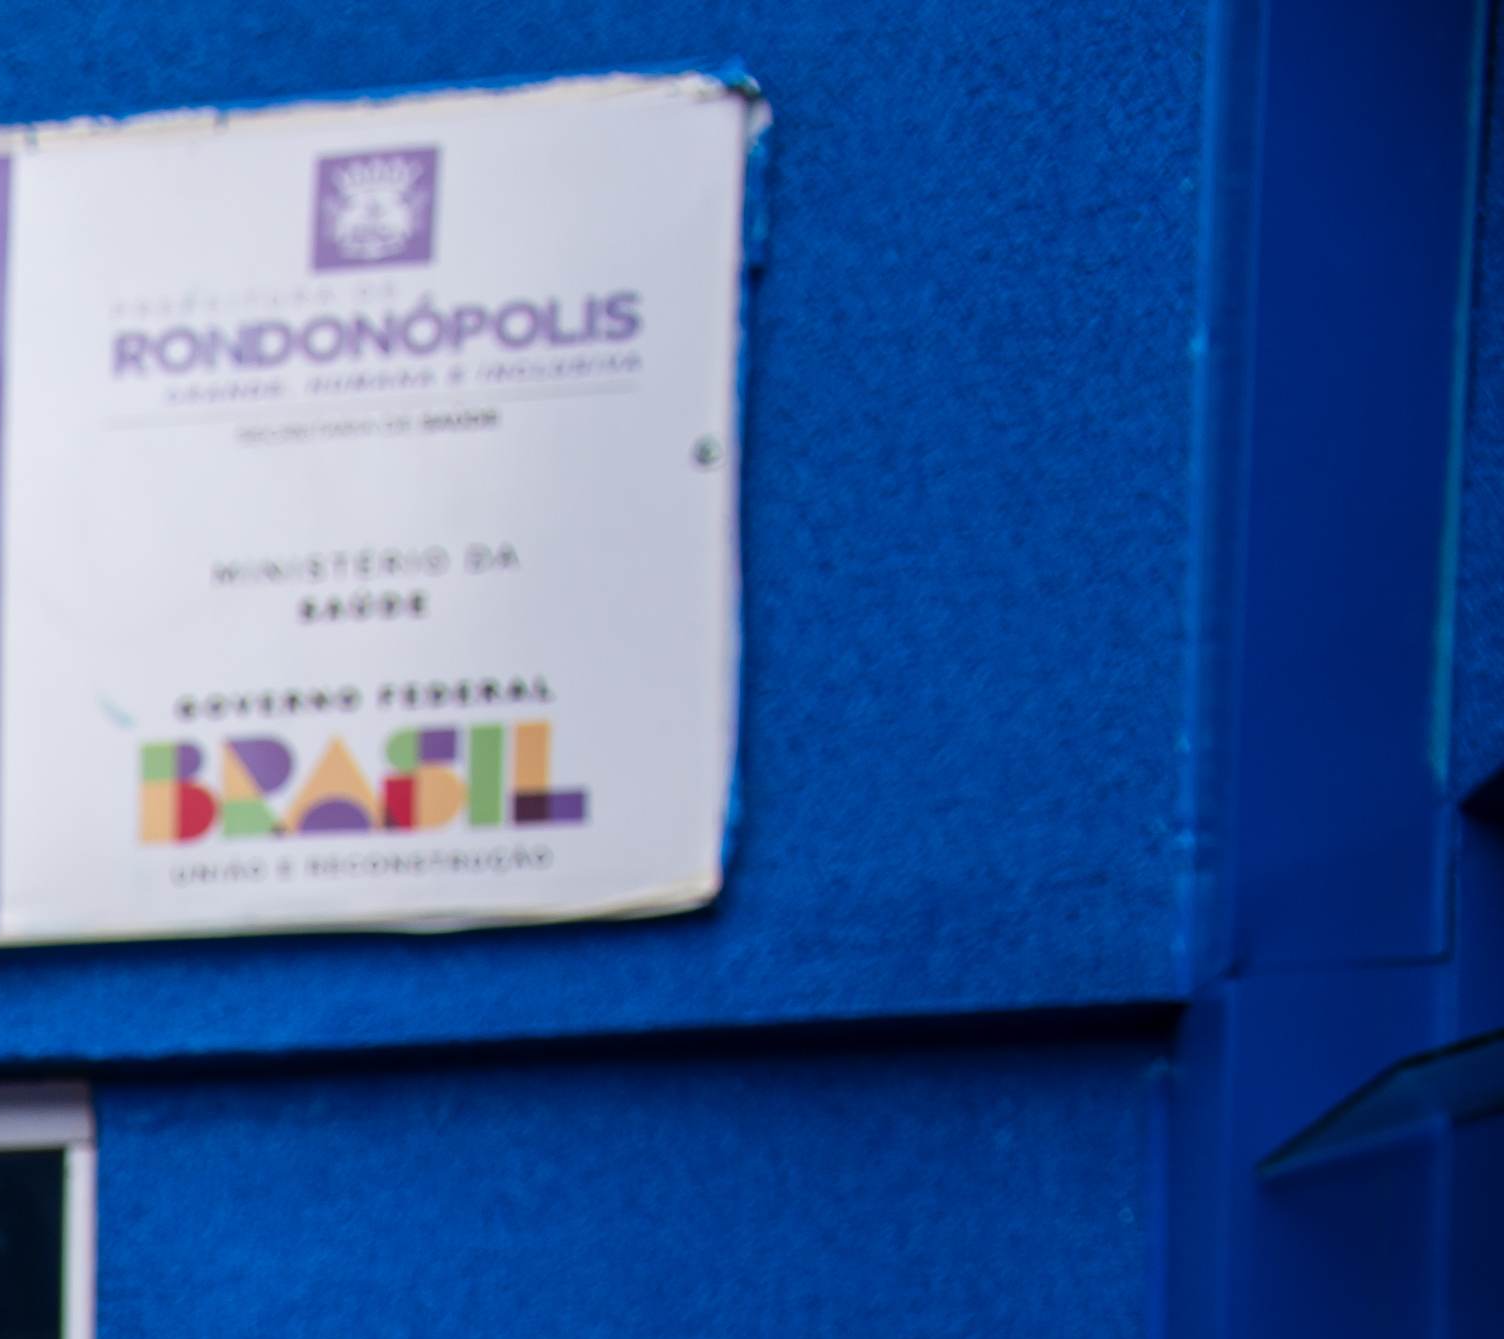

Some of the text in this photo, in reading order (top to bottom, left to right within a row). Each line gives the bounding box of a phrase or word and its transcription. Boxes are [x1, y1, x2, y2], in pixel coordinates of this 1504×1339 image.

[111, 288, 643, 378] RONDONÓPOLIS
[212, 541, 520, 587] MINISTÉRIO DA
[298, 588, 429, 624] SAÚDE
[176, 674, 554, 721] GOVERNO FEDERAL
[140, 720, 588, 845] BRASIL
